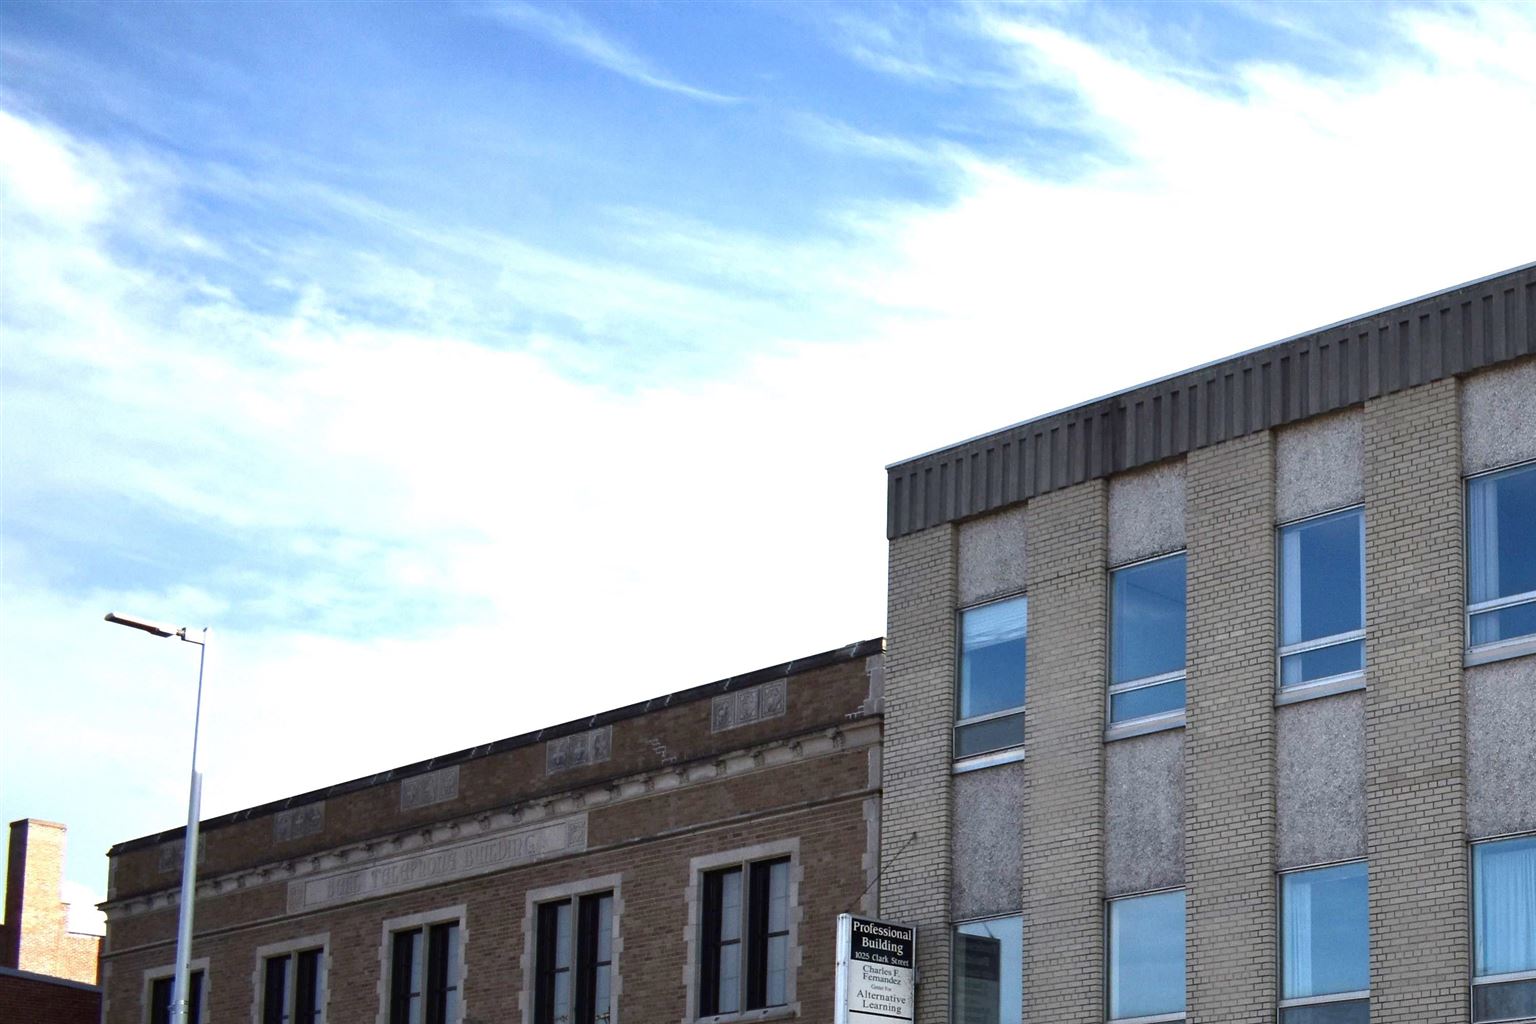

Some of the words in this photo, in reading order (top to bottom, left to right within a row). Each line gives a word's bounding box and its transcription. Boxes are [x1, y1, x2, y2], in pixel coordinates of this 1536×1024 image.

[464, 834, 537, 869] BUILDING
[853, 920, 912, 941] Professional
[862, 936, 904, 956] Building
[855, 951, 870, 960] 1025
[871, 953, 889, 963] Clark
[891, 957, 909, 967] Street
[862, 964, 892, 976] Charles
[862, 972, 902, 985] Fernandez
[856, 989, 906, 1005] Alternative
[862, 999, 902, 1015] Learning
